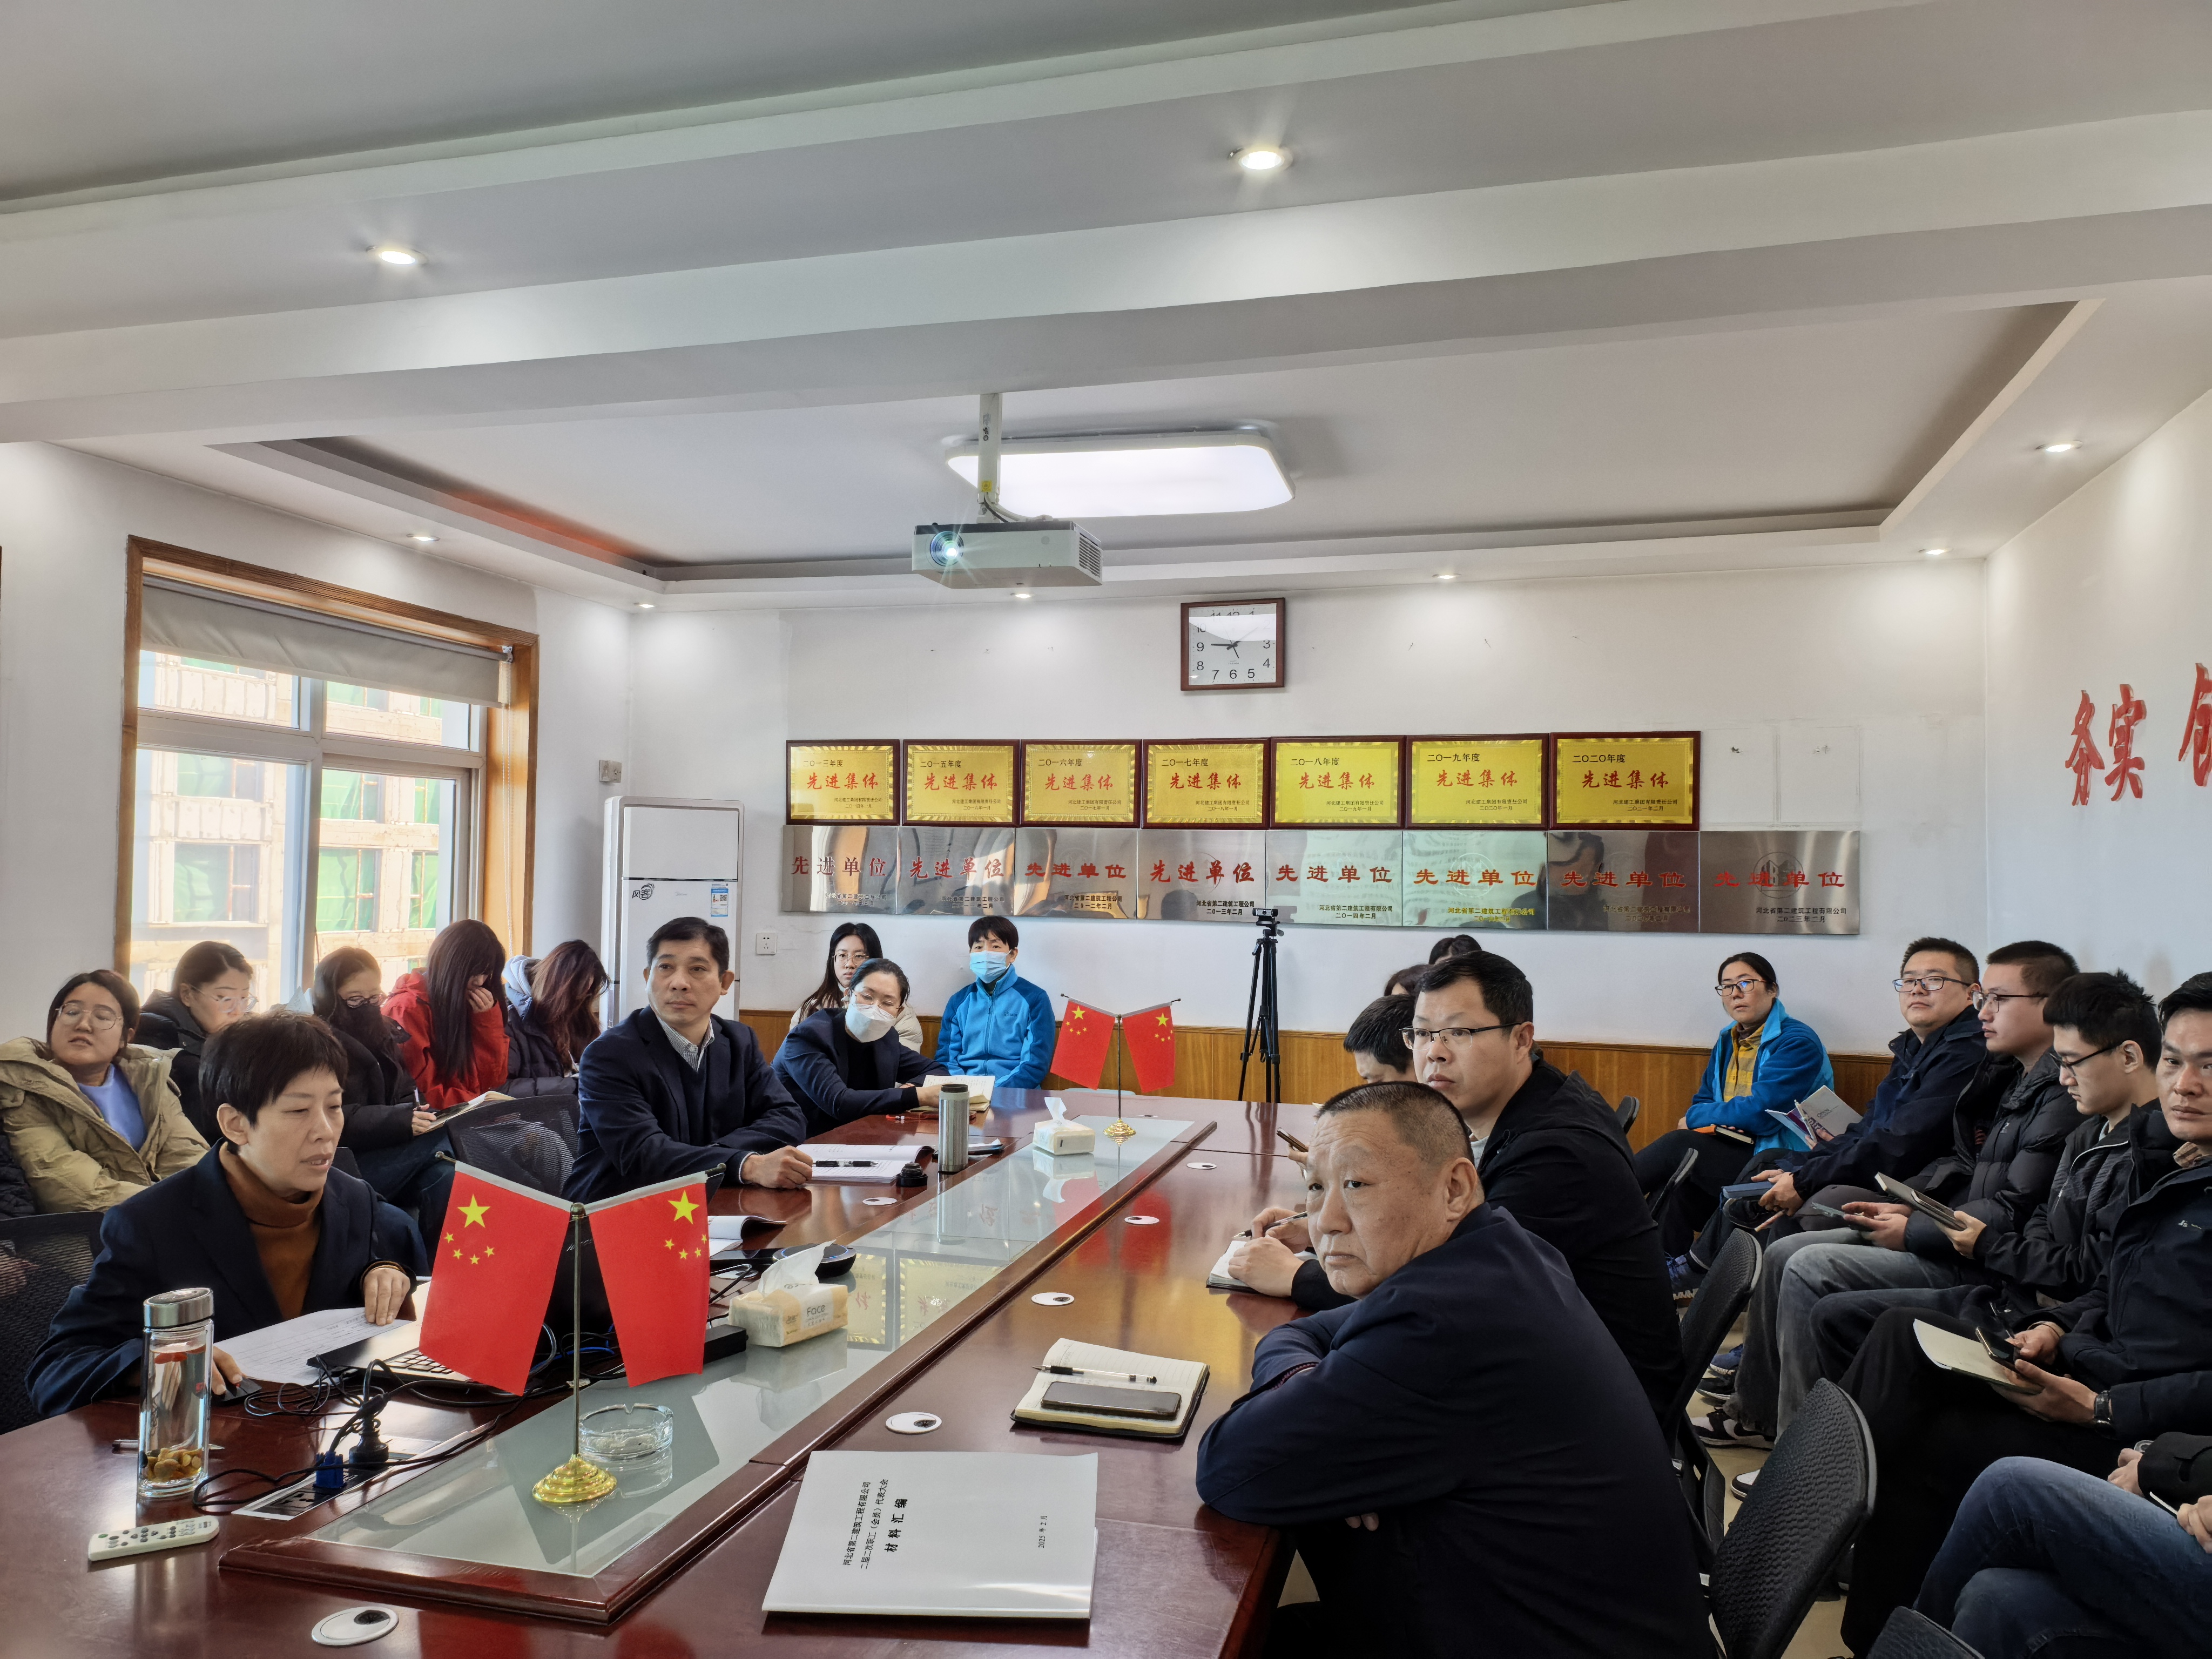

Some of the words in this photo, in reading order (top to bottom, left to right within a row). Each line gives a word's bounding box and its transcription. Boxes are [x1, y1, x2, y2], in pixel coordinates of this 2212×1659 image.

[1197, 642, 1204, 652] 9
[1197, 661, 1204, 671] 8
[1263, 658, 1271, 668] 4
[1212, 670, 1219, 680] 7
[1229, 670, 1237, 679] 6
[1247, 669, 1255, 678] 5
[807, 772, 878, 790] 先进集体
[925, 773, 997, 791] 先进集体
[1045, 773, 1113, 791] 先进集体
[1170, 772, 1242, 790] 先进集体
[1299, 772, 1375, 790] 先进集体
[1436, 770, 1518, 788] 先进集体
[1582, 770, 1669, 790] 先进集体
[791, 855, 886, 876] 先进单位
[909, 857, 1004, 880] 先进单位
[1024, 862, 1127, 879] 先进单位
[1150, 859, 1255, 885] 先进单位
[1276, 864, 1392, 882] 先进单位
[1413, 868, 1537, 886] 先进单位
[1561, 871, 1686, 887] 先进单位
[1714, 871, 1845, 887] 先进单位
[842, 1481, 871, 1566] 河北省第二建筑工程有限公司
[884, 1498, 908, 1553] 材料汇编
